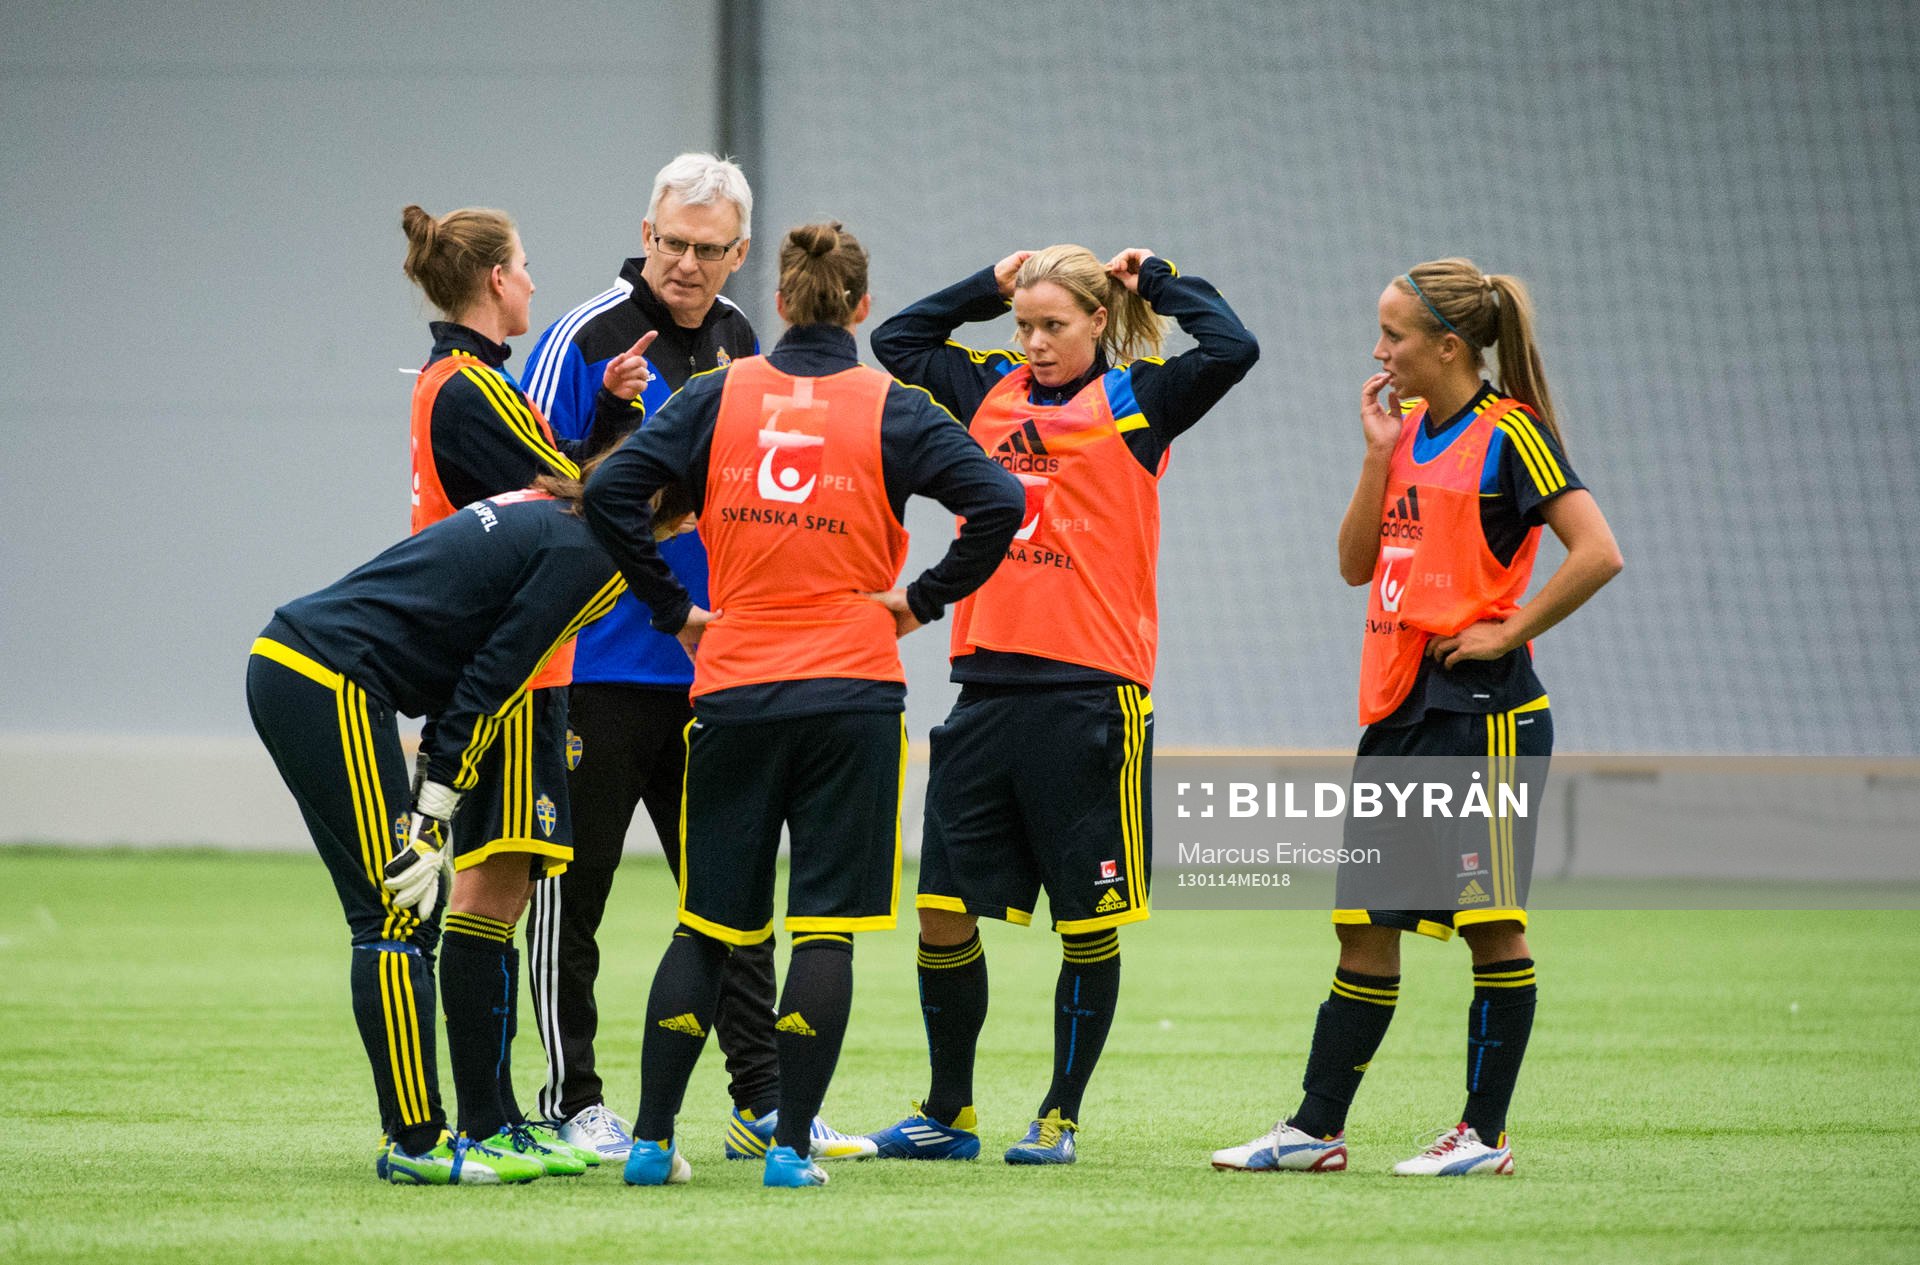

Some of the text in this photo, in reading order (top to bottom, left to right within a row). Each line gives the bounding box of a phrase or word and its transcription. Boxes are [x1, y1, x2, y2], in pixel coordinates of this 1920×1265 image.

[721, 507, 849, 535] SVENSKA SPEL
[1033, 550, 1074, 571] SPEL
[1095, 900, 1127, 913] adidas
